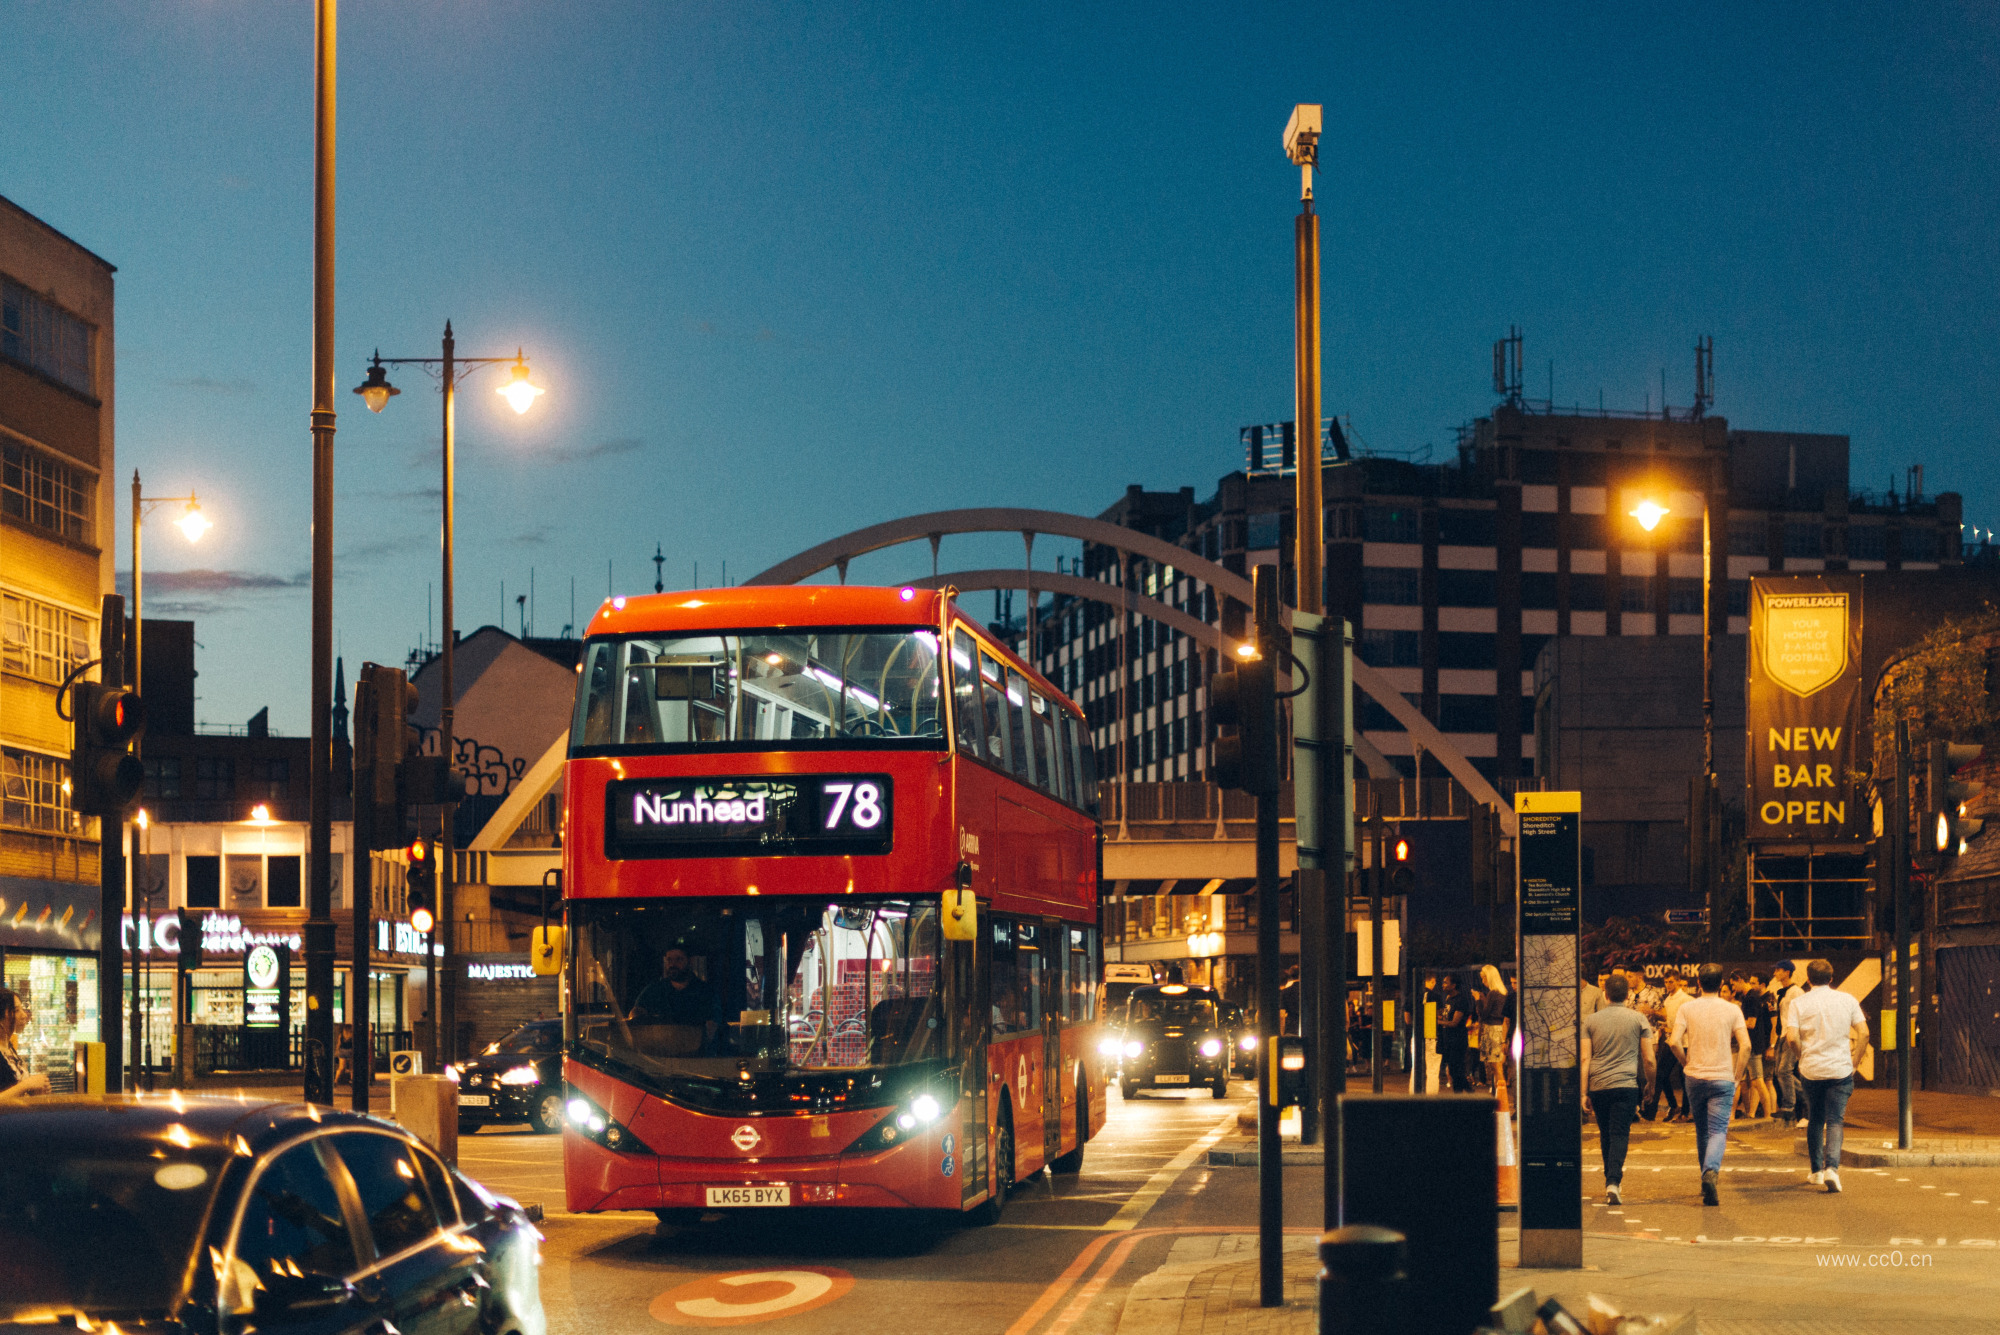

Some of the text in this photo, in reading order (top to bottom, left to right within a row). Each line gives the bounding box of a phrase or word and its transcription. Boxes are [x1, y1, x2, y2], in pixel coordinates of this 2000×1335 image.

[1768, 597, 1845, 608] POWERLEAGUE
[1793, 620, 1820, 628] YOUR
[1783, 630, 1829, 640] HOME OF
[1781, 653, 1830, 662] FOOTBALL
[1769, 727, 1842, 751] NEW
[1774, 764, 1836, 788] BAR
[634, 783, 882, 828] Nunhead 78
[1761, 801, 1845, 825] OPEN
[468, 964, 537, 980] MAJESTIC
[713, 1189, 783, 1203] LK65 BYX
